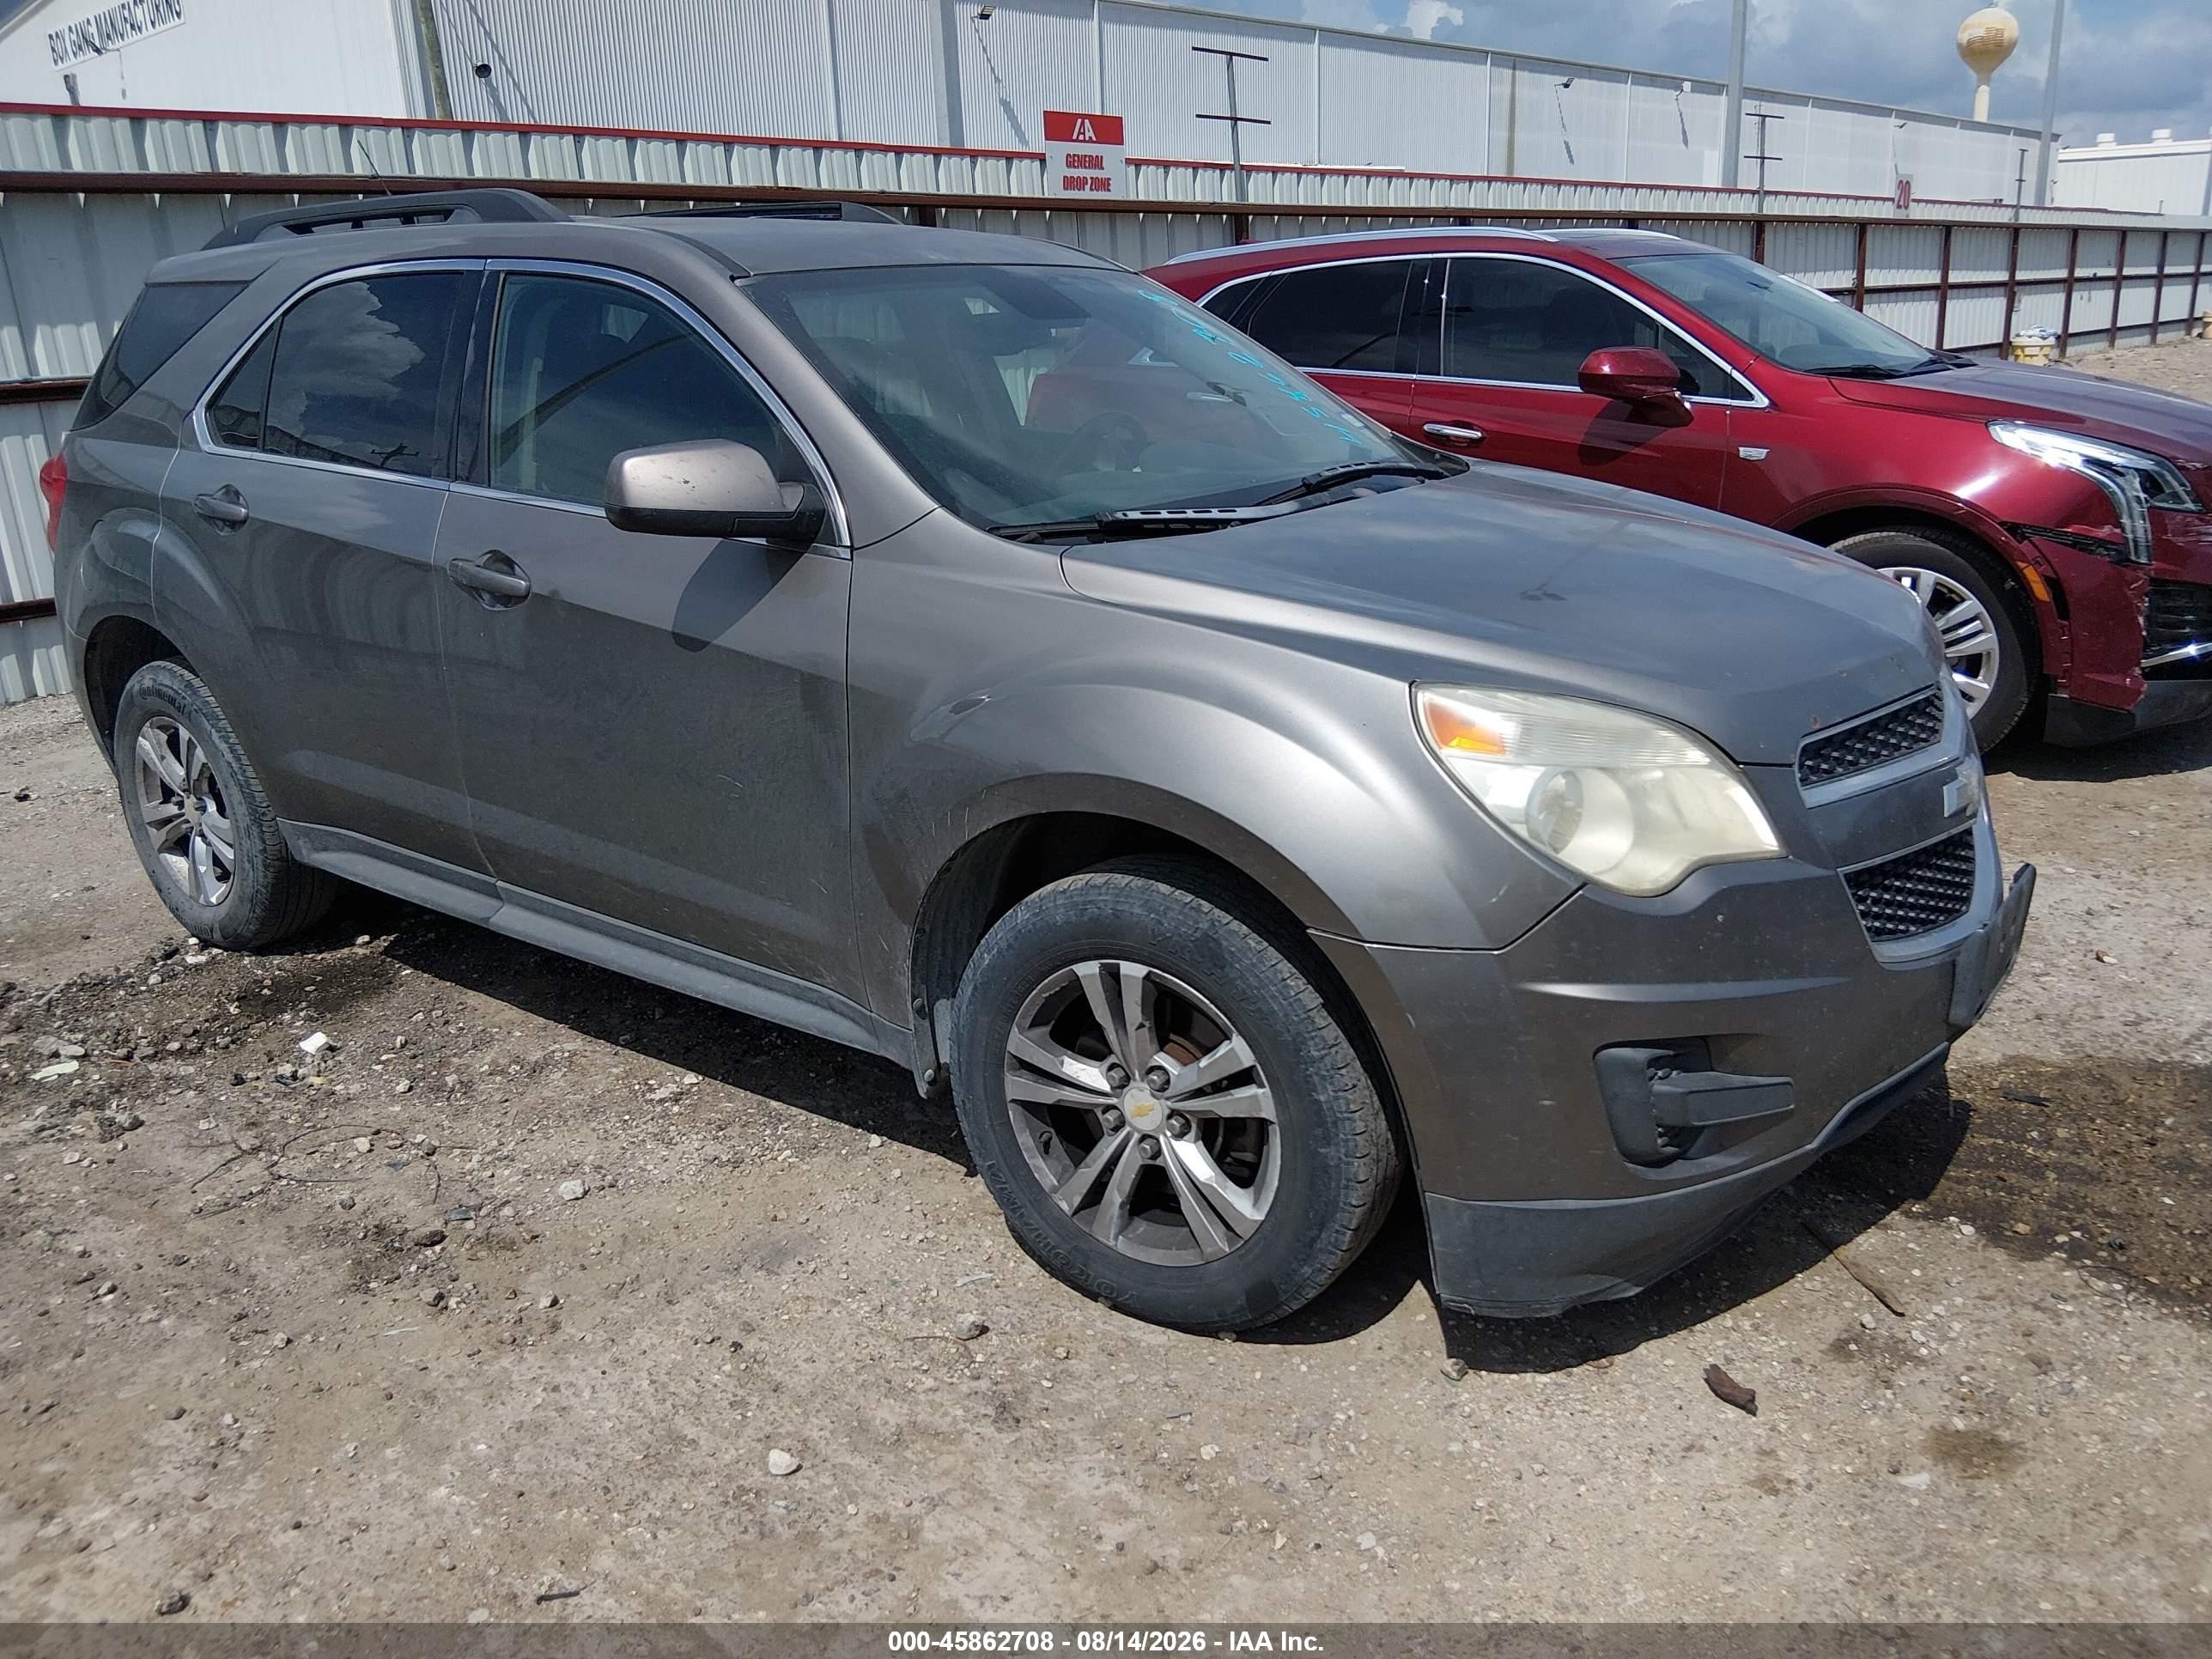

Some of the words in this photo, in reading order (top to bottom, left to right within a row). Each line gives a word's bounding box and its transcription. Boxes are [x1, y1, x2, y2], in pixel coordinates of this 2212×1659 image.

[48, 27, 71, 66] BOX
[94, 0, 182, 49] MANUFACTURING
[1066, 153, 1105, 171] GENERAL
[1062, 175, 1089, 191] DROP
[1089, 177, 1111, 192] ZONE
[1896, 179, 1911, 210] 20
